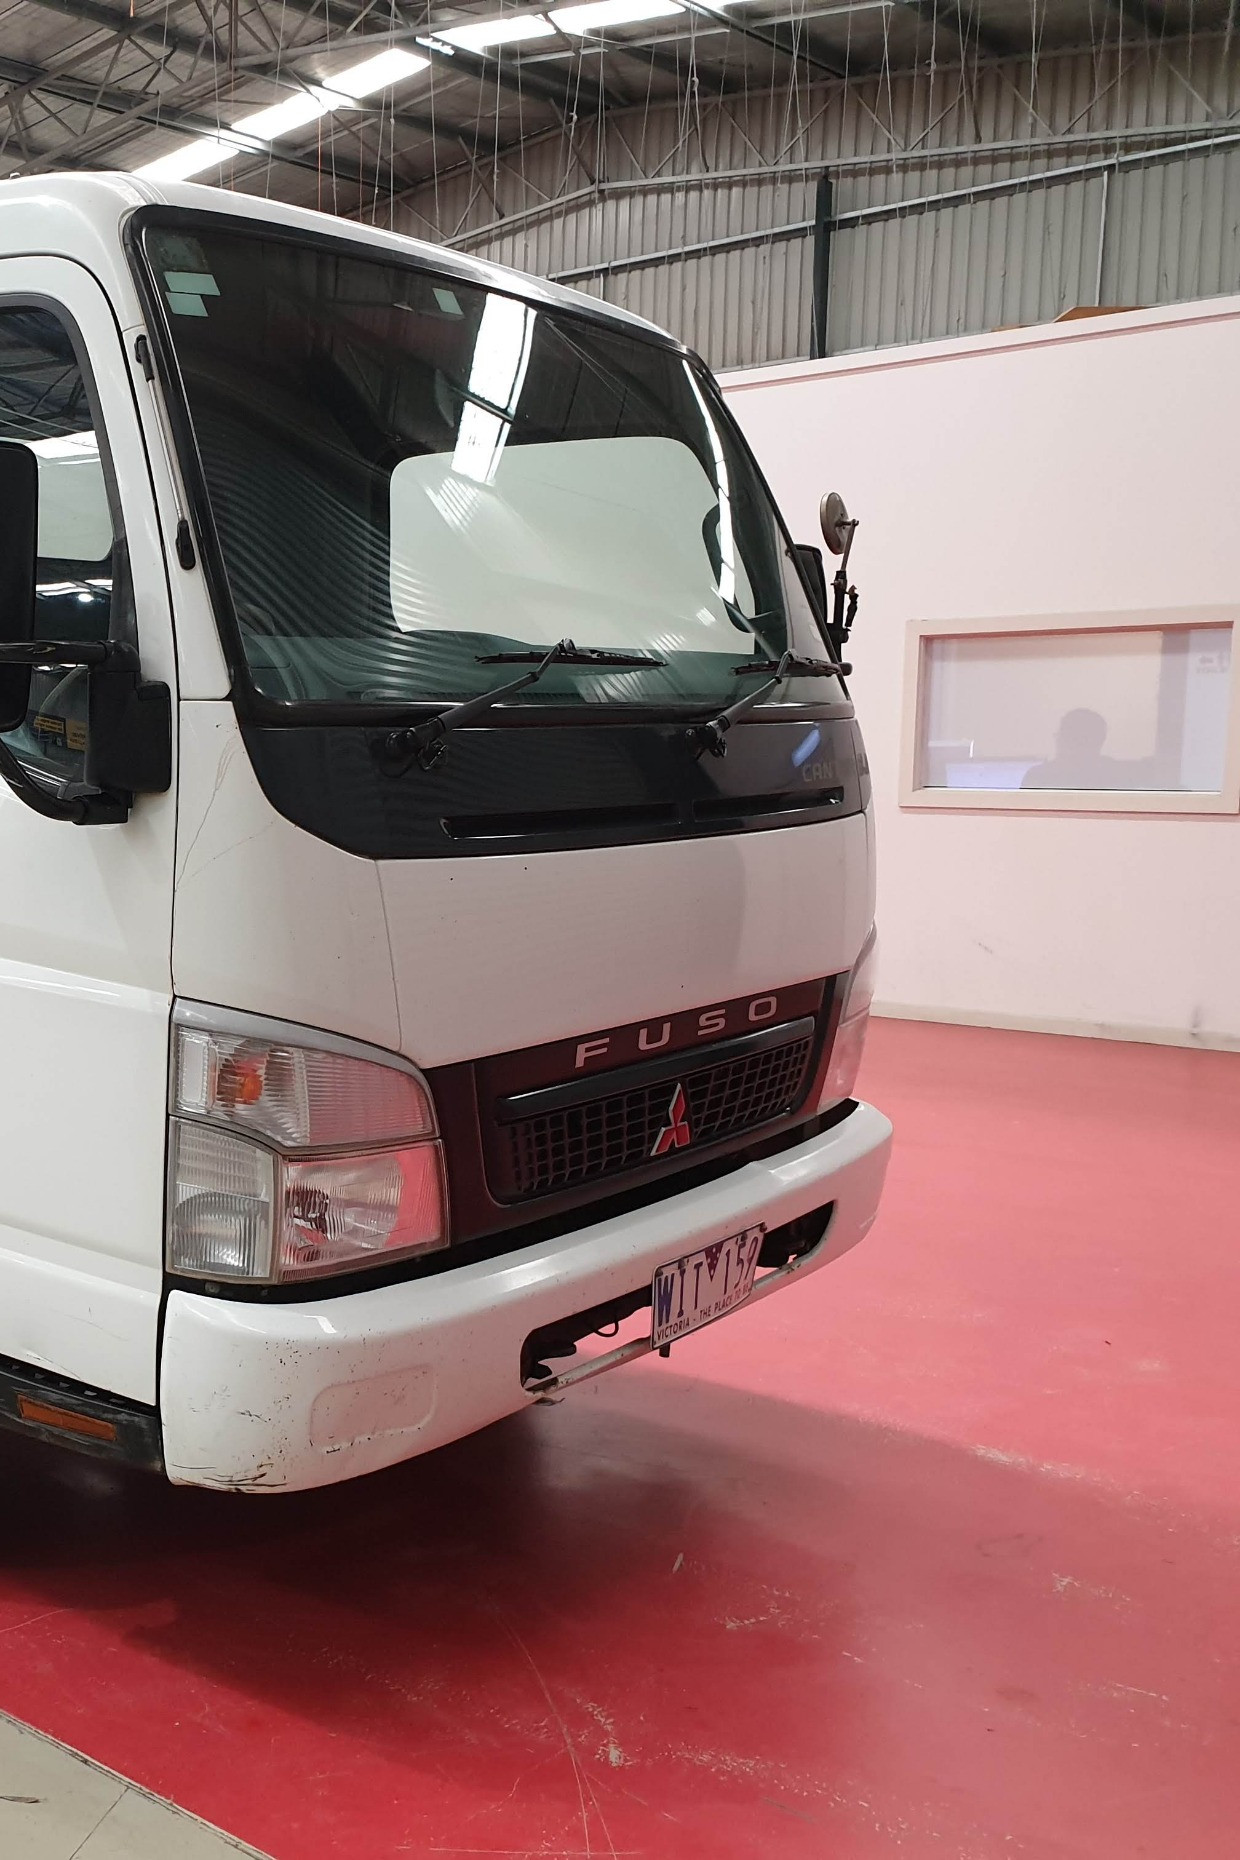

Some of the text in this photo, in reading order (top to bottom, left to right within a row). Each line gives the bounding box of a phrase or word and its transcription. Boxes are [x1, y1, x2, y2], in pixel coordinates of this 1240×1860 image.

[574, 996, 778, 1069] FUSO
[657, 1235, 759, 1327] WIT 159
[657, 1318, 690, 1340] VICTORIA
[700, 1306, 711, 1319] THE
